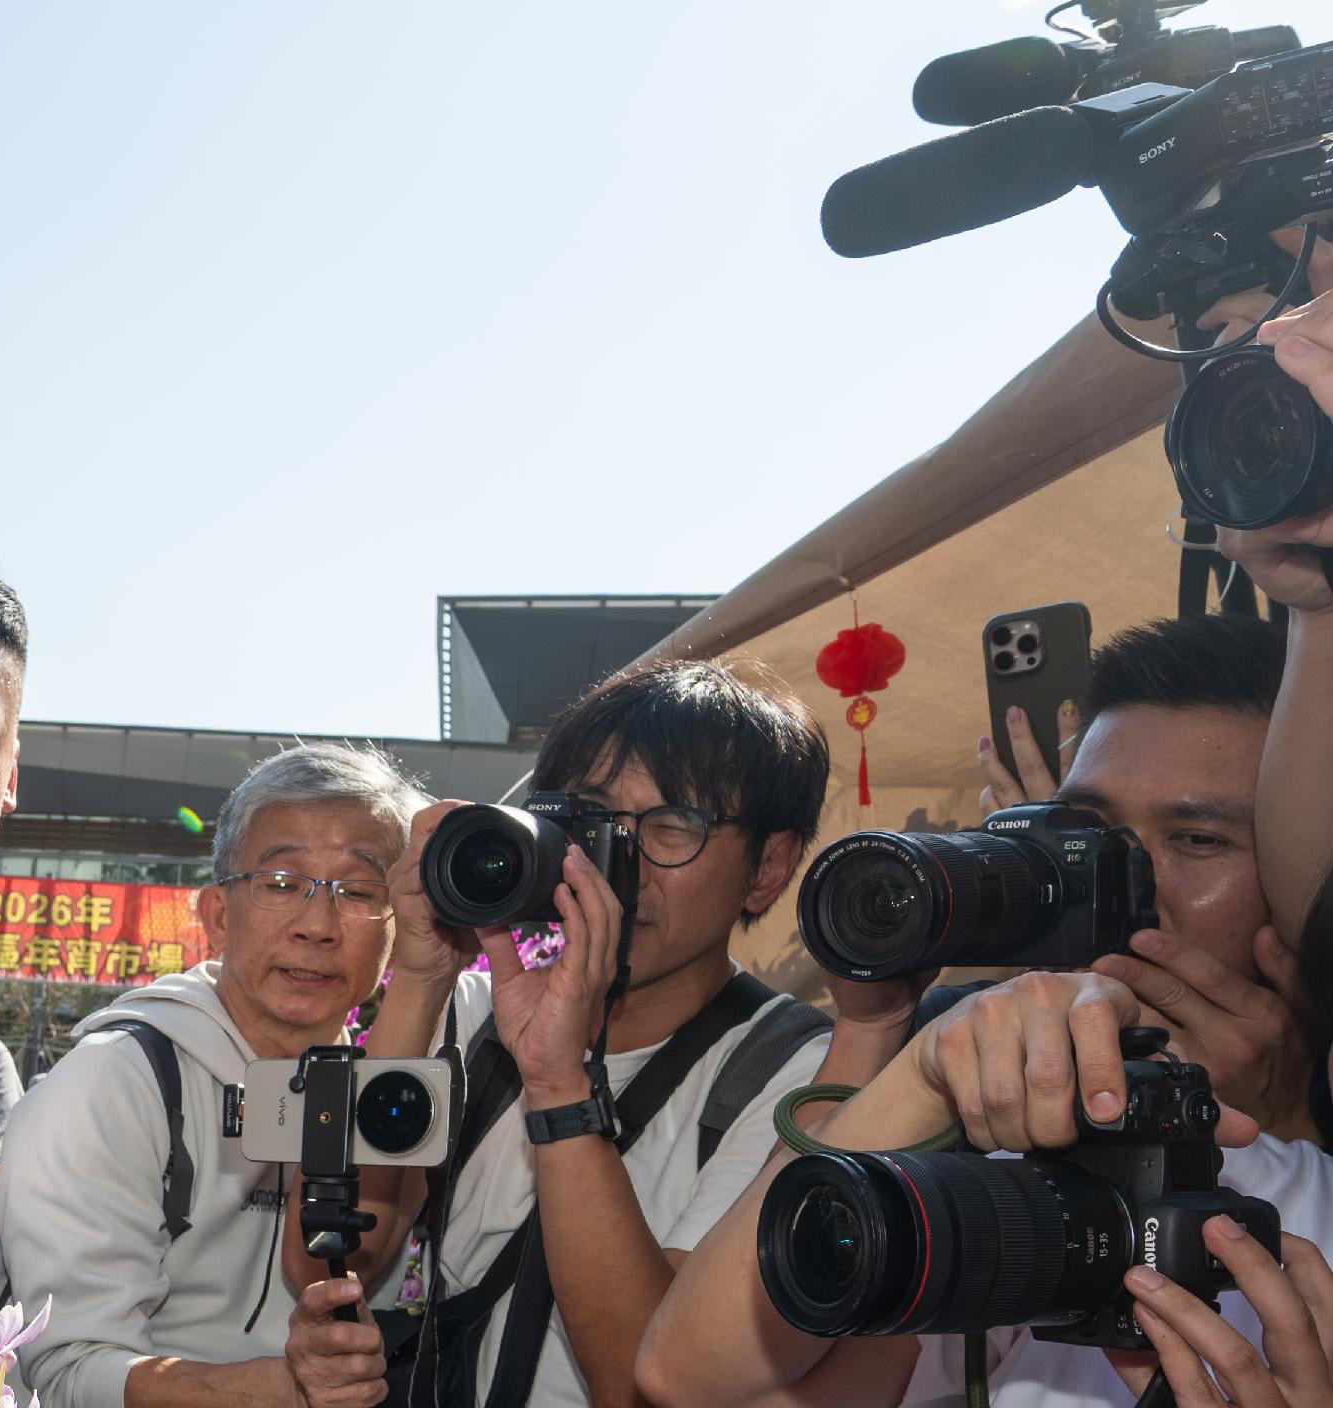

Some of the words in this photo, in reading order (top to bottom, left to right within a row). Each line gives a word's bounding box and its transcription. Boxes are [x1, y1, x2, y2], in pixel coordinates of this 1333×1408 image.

[1138, 136, 1176, 164] SONY
[987, 819, 1031, 831] Canon
[1064, 840, 1087, 850] EOS
[813, 861, 829, 880] CANON
[828, 848, 845, 861] ZOOM
[846, 842, 860, 851] LENS
[278, 1096, 288, 1126] vivo
[1086, 1226, 1094, 1264] Canon
